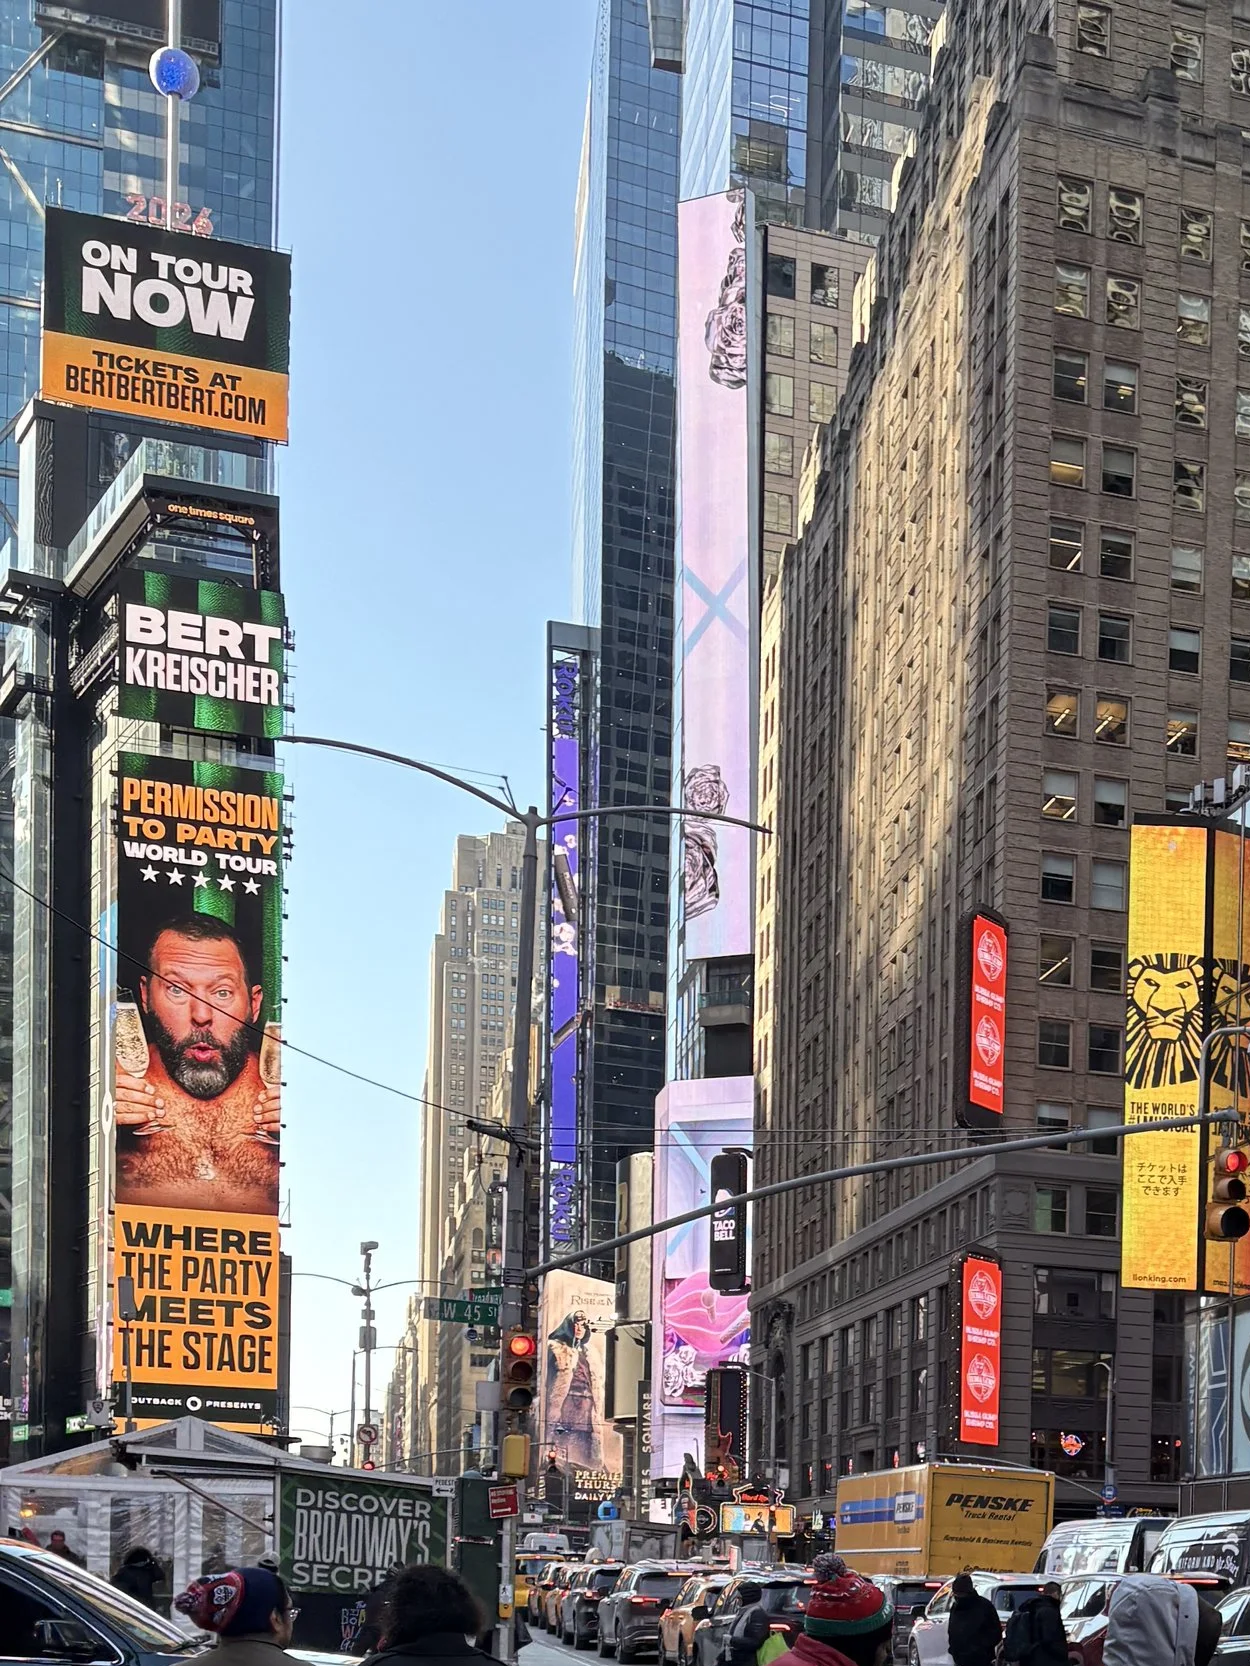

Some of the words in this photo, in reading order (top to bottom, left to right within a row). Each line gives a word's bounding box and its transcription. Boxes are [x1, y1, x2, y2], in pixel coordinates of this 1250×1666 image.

[126, 193, 214, 238] 2026
[82, 240, 137, 273] ON
[150, 252, 255, 295] TOUR
[82, 266, 255, 342] NOW
[92, 350, 200, 385] TICKETS
[209, 372, 242, 392] AT
[65, 364, 266, 425] BERTBERTBERT.COM
[168, 504, 188, 514] one
[188, 505, 218, 519] times
[219, 512, 255, 526] square
[125, 604, 281, 663] BERT
[125, 646, 280, 706] KREISCHER
[122, 776, 278, 831] PERMISSION
[122, 816, 167, 840] TO
[176, 826, 279, 855] PARTY
[122, 840, 208, 867] WORLD
[214, 852, 278, 877] TOUR
[1130, 1101, 1149, 1115] THE
[1151, 1103, 1196, 1116] WORLD'S
[1137, 1162, 1188, 1173] チケットは
[1137, 1174, 1188, 1186] ここで入手
[1143, 1185, 1181, 1197] できます
[121, 1221, 272, 1256] WHERE
[712, 1220, 736, 1230] TACO
[713, 1230, 736, 1241] BELL
[121, 1252, 172, 1290] THE
[182, 1255, 273, 1297] PARTY
[1132, 1274, 1187, 1284] lionking.com
[132, 1295, 273, 1329] MEETS
[444, 1302, 456, 1319] W
[464, 1305, 480, 1321] 45
[118, 1328, 172, 1368] THE
[183, 1331, 273, 1374] STAGE
[131, 1397, 182, 1406] OUTBACK
[206, 1401, 261, 1410] PRESENTS
[642, 1393, 652, 1454] SQUARE
[296, 1488, 432, 1520] DISCOVER
[641, 1469, 651, 1514] TIMES
[895, 1502, 914, 1514] PENSKE
[945, 1493, 1035, 1512] PENSKE
[964, 1511, 987, 1519] Truck
[987, 1512, 1016, 1521] Rental
[294, 1509, 431, 1566] BROADWAY'S
[943, 1534, 975, 1543] Household
[1202, 1555, 1215, 1568] AND
